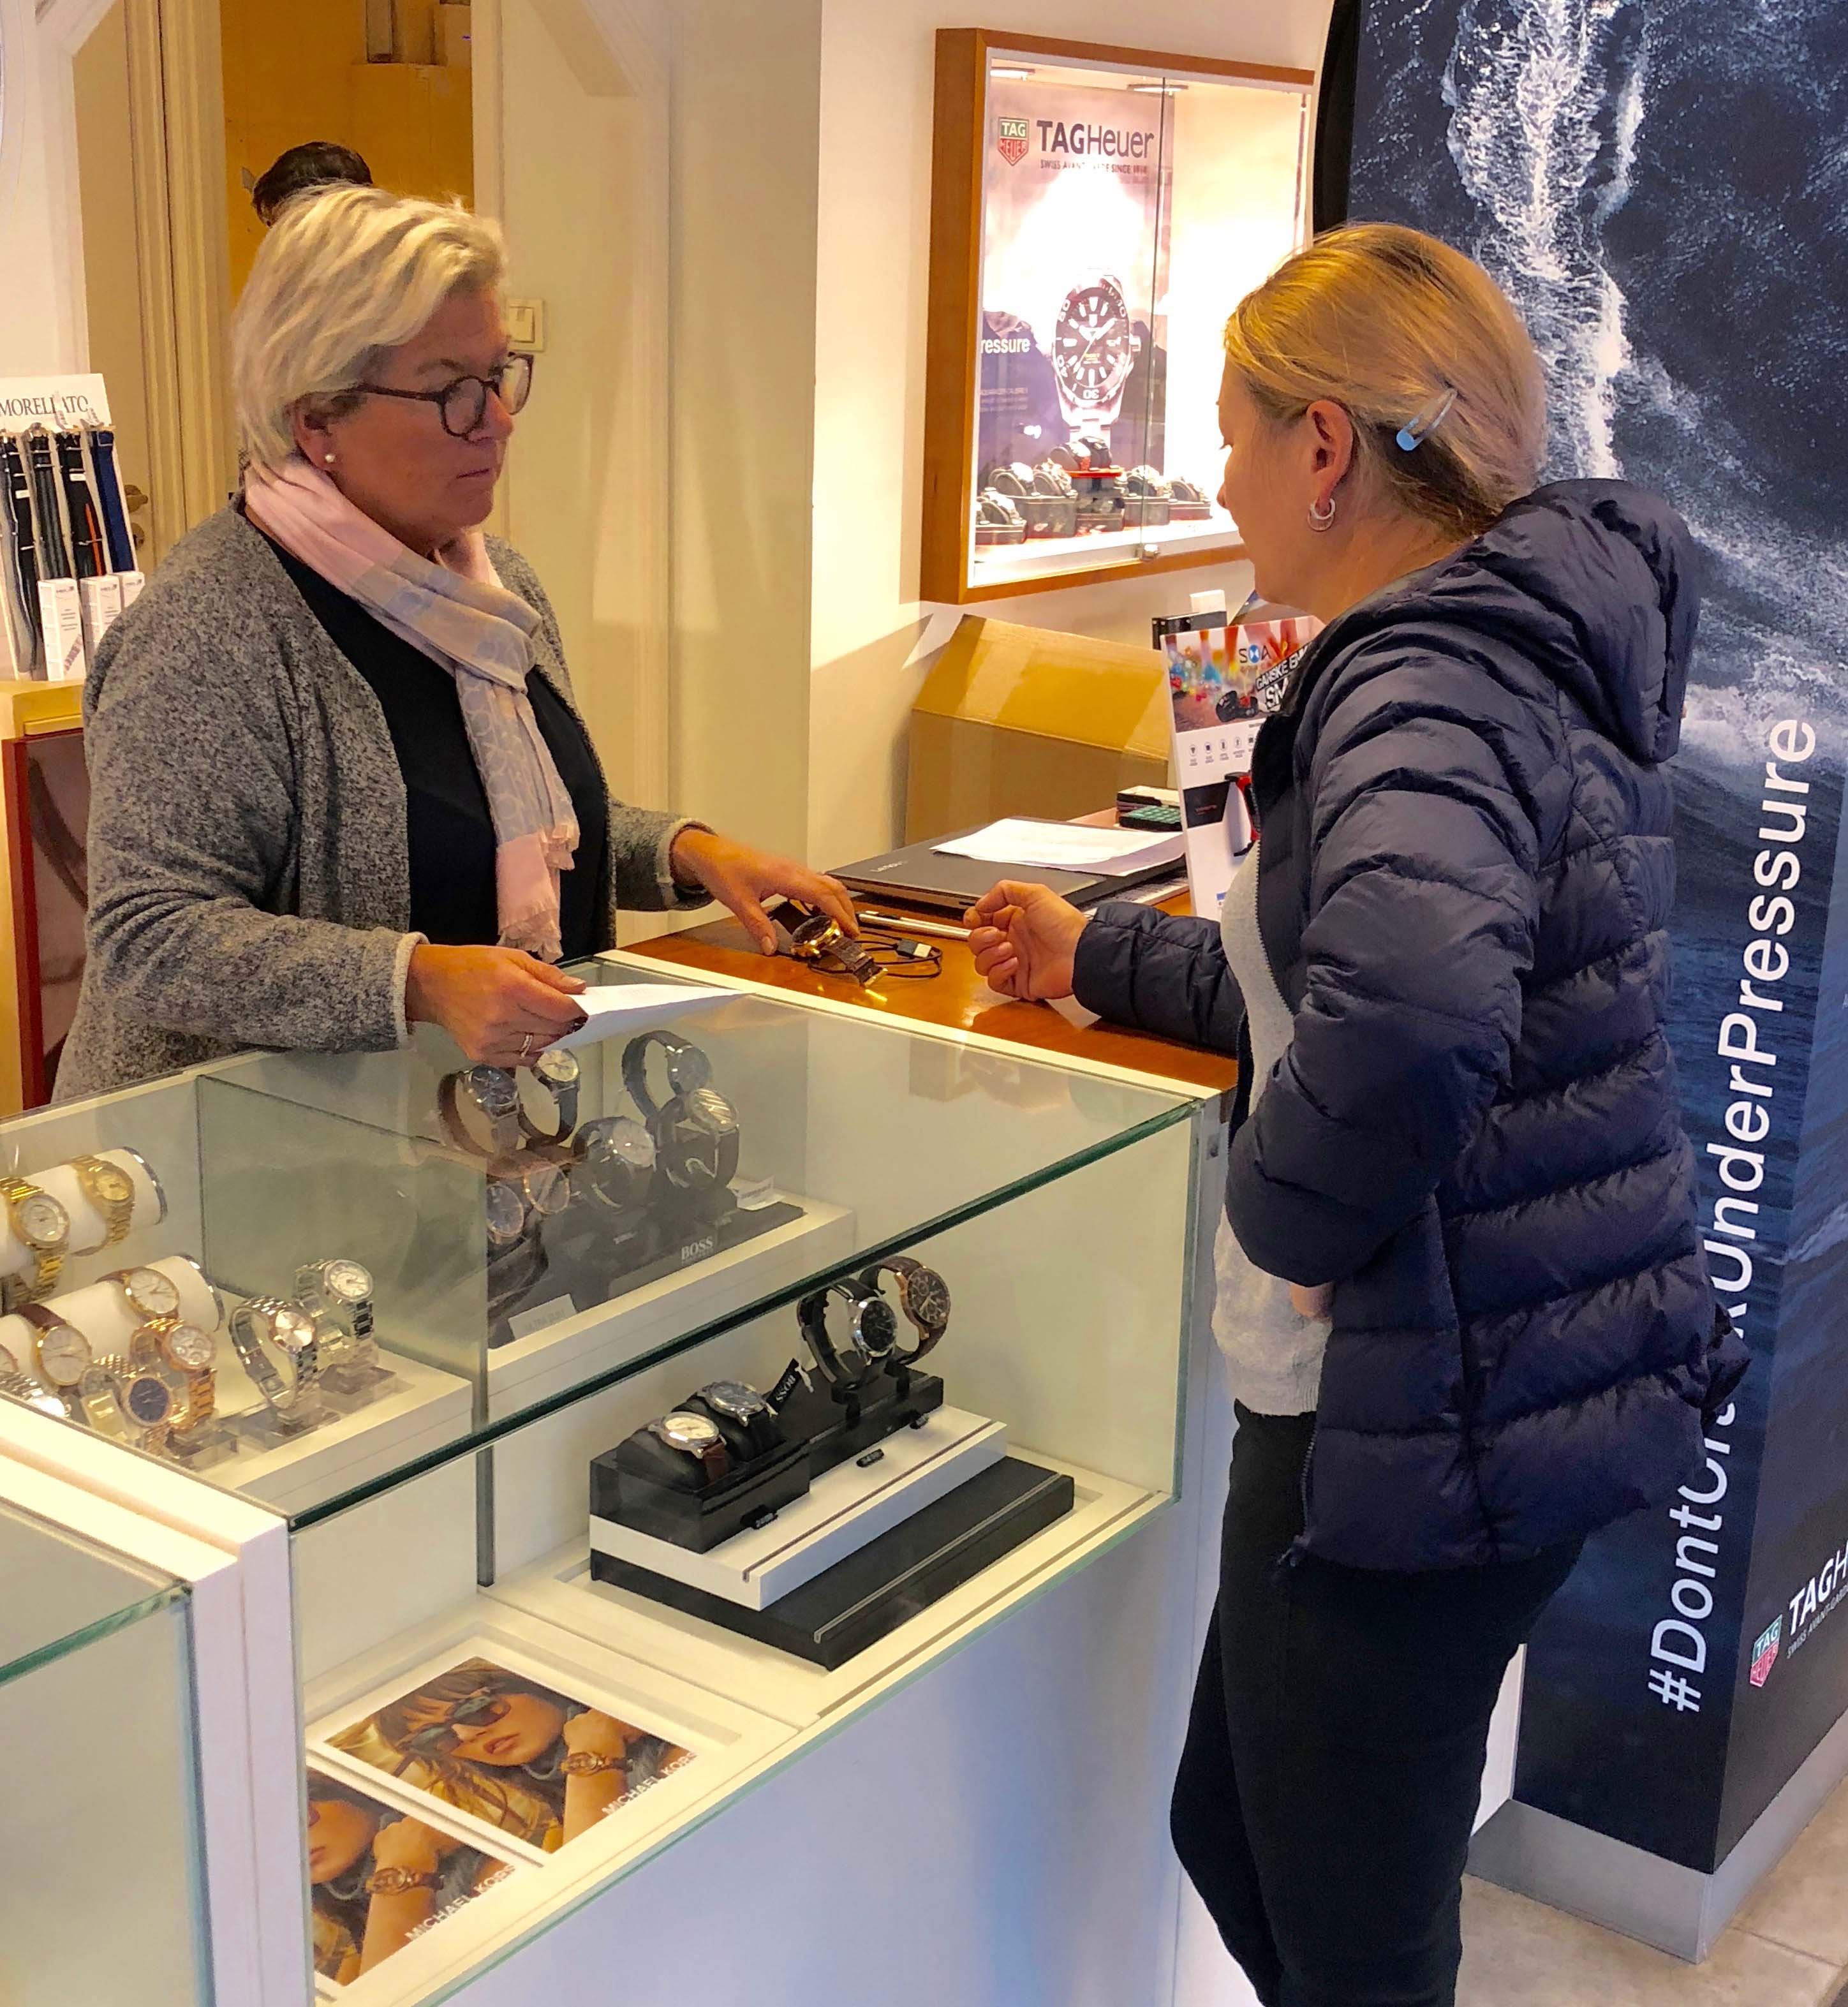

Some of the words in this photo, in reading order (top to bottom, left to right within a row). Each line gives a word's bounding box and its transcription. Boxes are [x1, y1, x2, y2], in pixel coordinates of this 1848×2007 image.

[1002, 122, 1026, 137] TAG
[999, 138, 1027, 161] HEUER
[1040, 159, 1061, 170] SWISS
[1111, 165, 1132, 174] SINCE
[1256, 658, 1289, 690] GANSKE
[681, 1235, 714, 1261] BOSS
[1756, 1622, 1779, 1657] TAG
[602, 1775, 659, 1814] MICHAEL
[404, 1893, 471, 1940] MICHAEL
